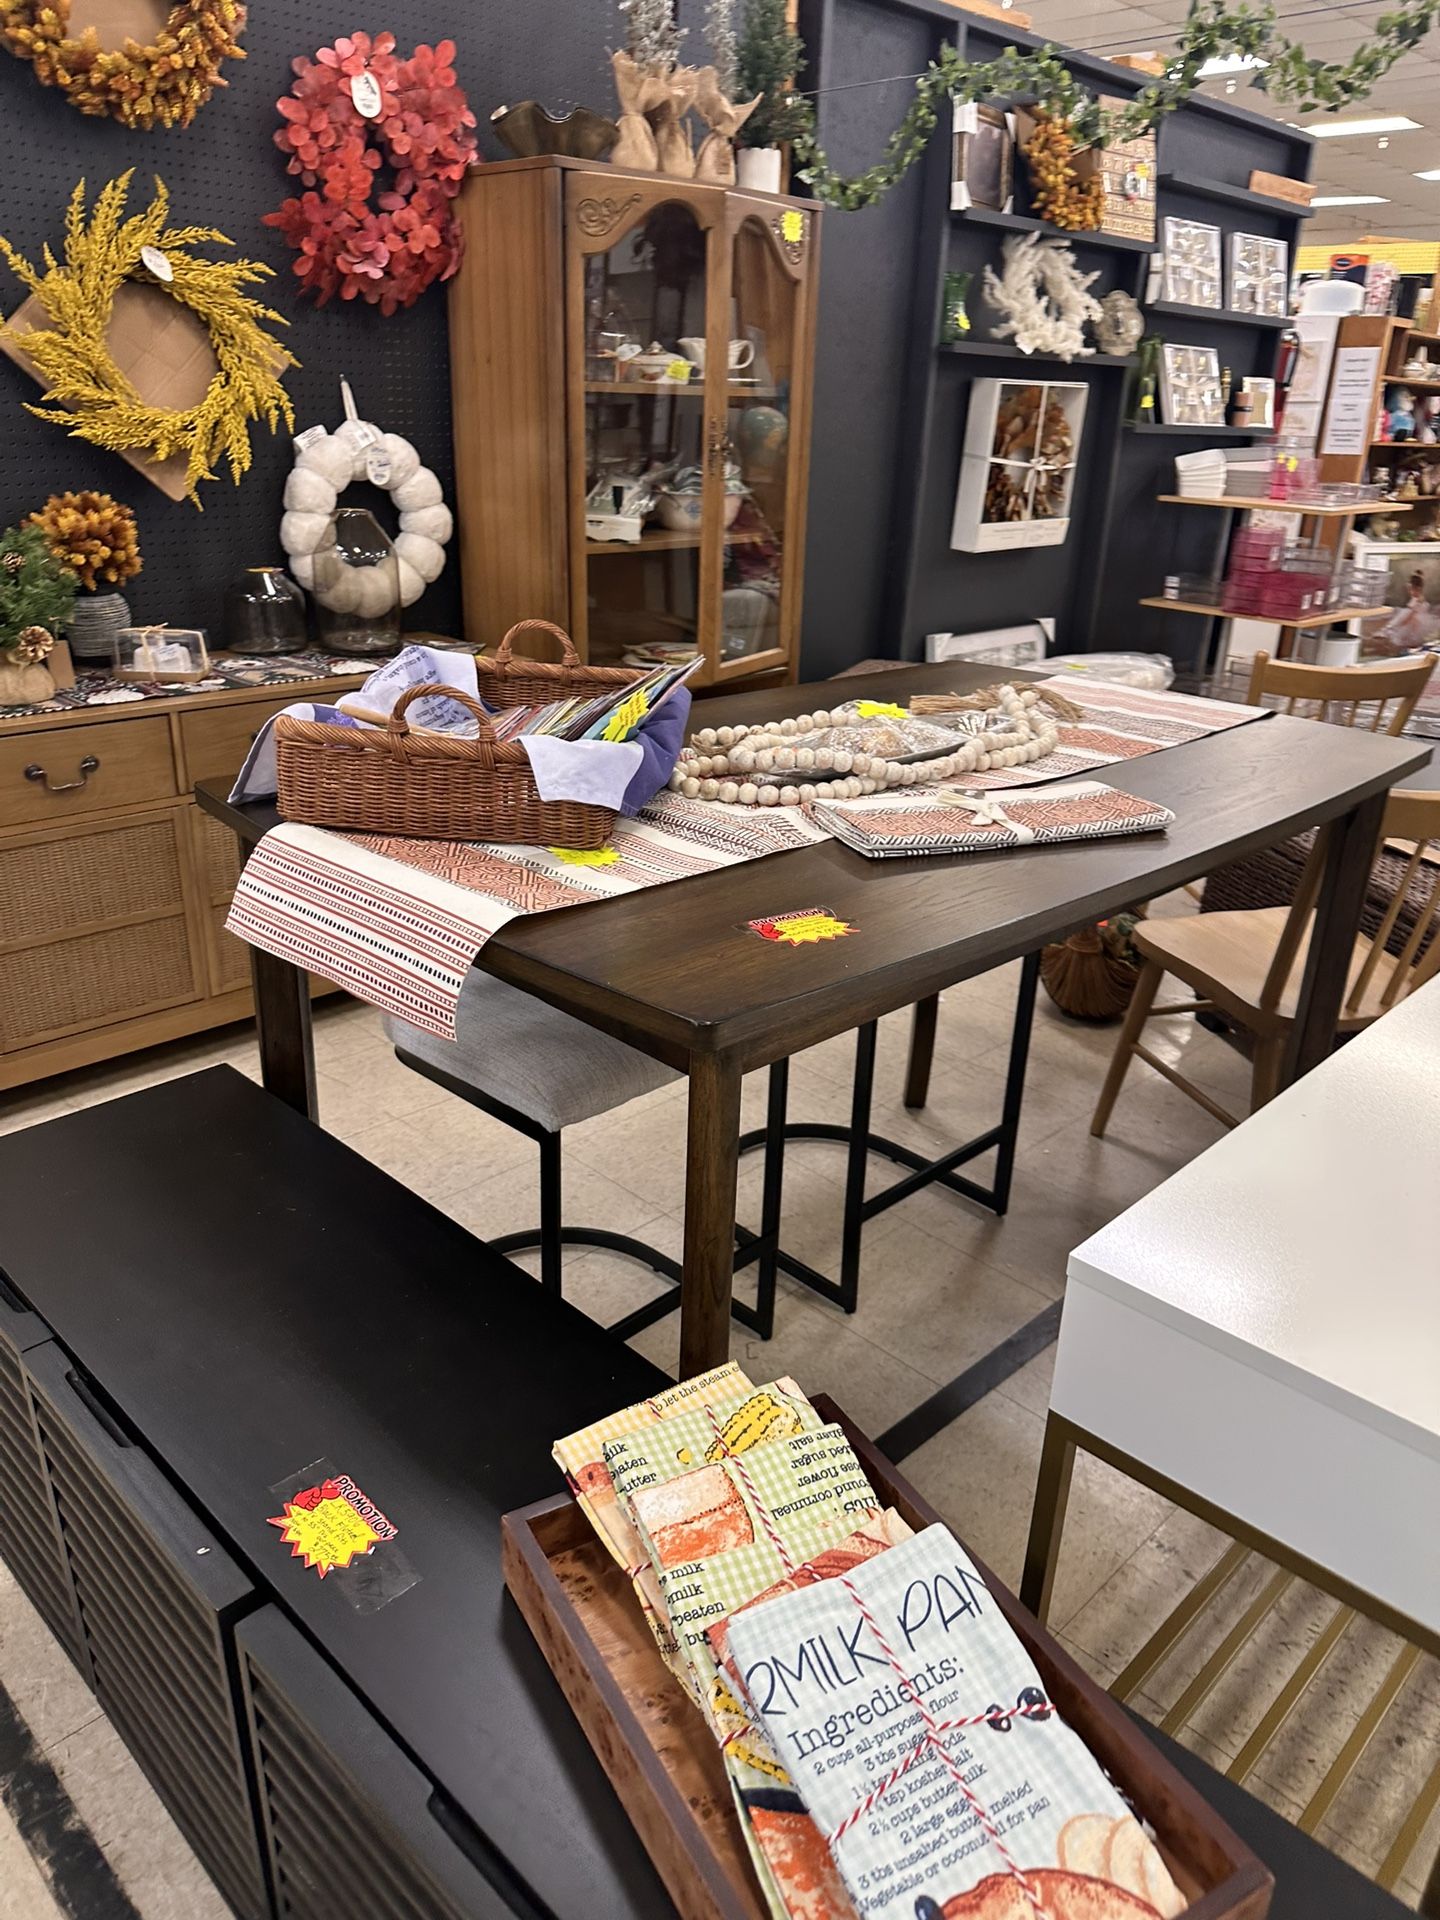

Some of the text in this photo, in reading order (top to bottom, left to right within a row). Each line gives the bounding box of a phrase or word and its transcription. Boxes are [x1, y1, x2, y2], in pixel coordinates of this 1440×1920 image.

[752, 909, 823, 926] PROMOTION
[651, 1400, 664, 1413] o
[662, 1393, 680, 1408] let
[679, 1384, 699, 1399] the
[699, 1369, 732, 1389] steam
[788, 1434, 814, 1451] salt
[790, 1444, 851, 1470] ted sugar
[617, 1471, 657, 1494] utter
[797, 1465, 840, 1488] flower
[336, 1477, 396, 1539] PROMOTION
[770, 1477, 870, 1521] ound cornmeal
[670, 1562, 705, 1579] milk
[787, 1656, 964, 1760] Ingredients:
[813, 1760, 827, 1777] 2
[826, 1748, 855, 1770] cups
[928, 1688, 960, 1715] flour
[863, 1727, 930, 1772] 3 tbs sugar
[941, 1730, 967, 1751] oda
[882, 1788, 907, 1808] tsp
[903, 1762, 948, 1795] kosher
[889, 1802, 922, 1828] cups
[899, 1830, 913, 1846] 2
[910, 1812, 946, 1839] large
[857, 1875, 870, 1891] 3
[870, 1863, 895, 1883] tbs
[896, 1832, 950, 1872] unsalted
[989, 1780, 1034, 1816] melted
[924, 1862, 940, 1879] or
[1005, 1808, 1026, 1830] for
[1026, 1797, 1051, 1820] pan
